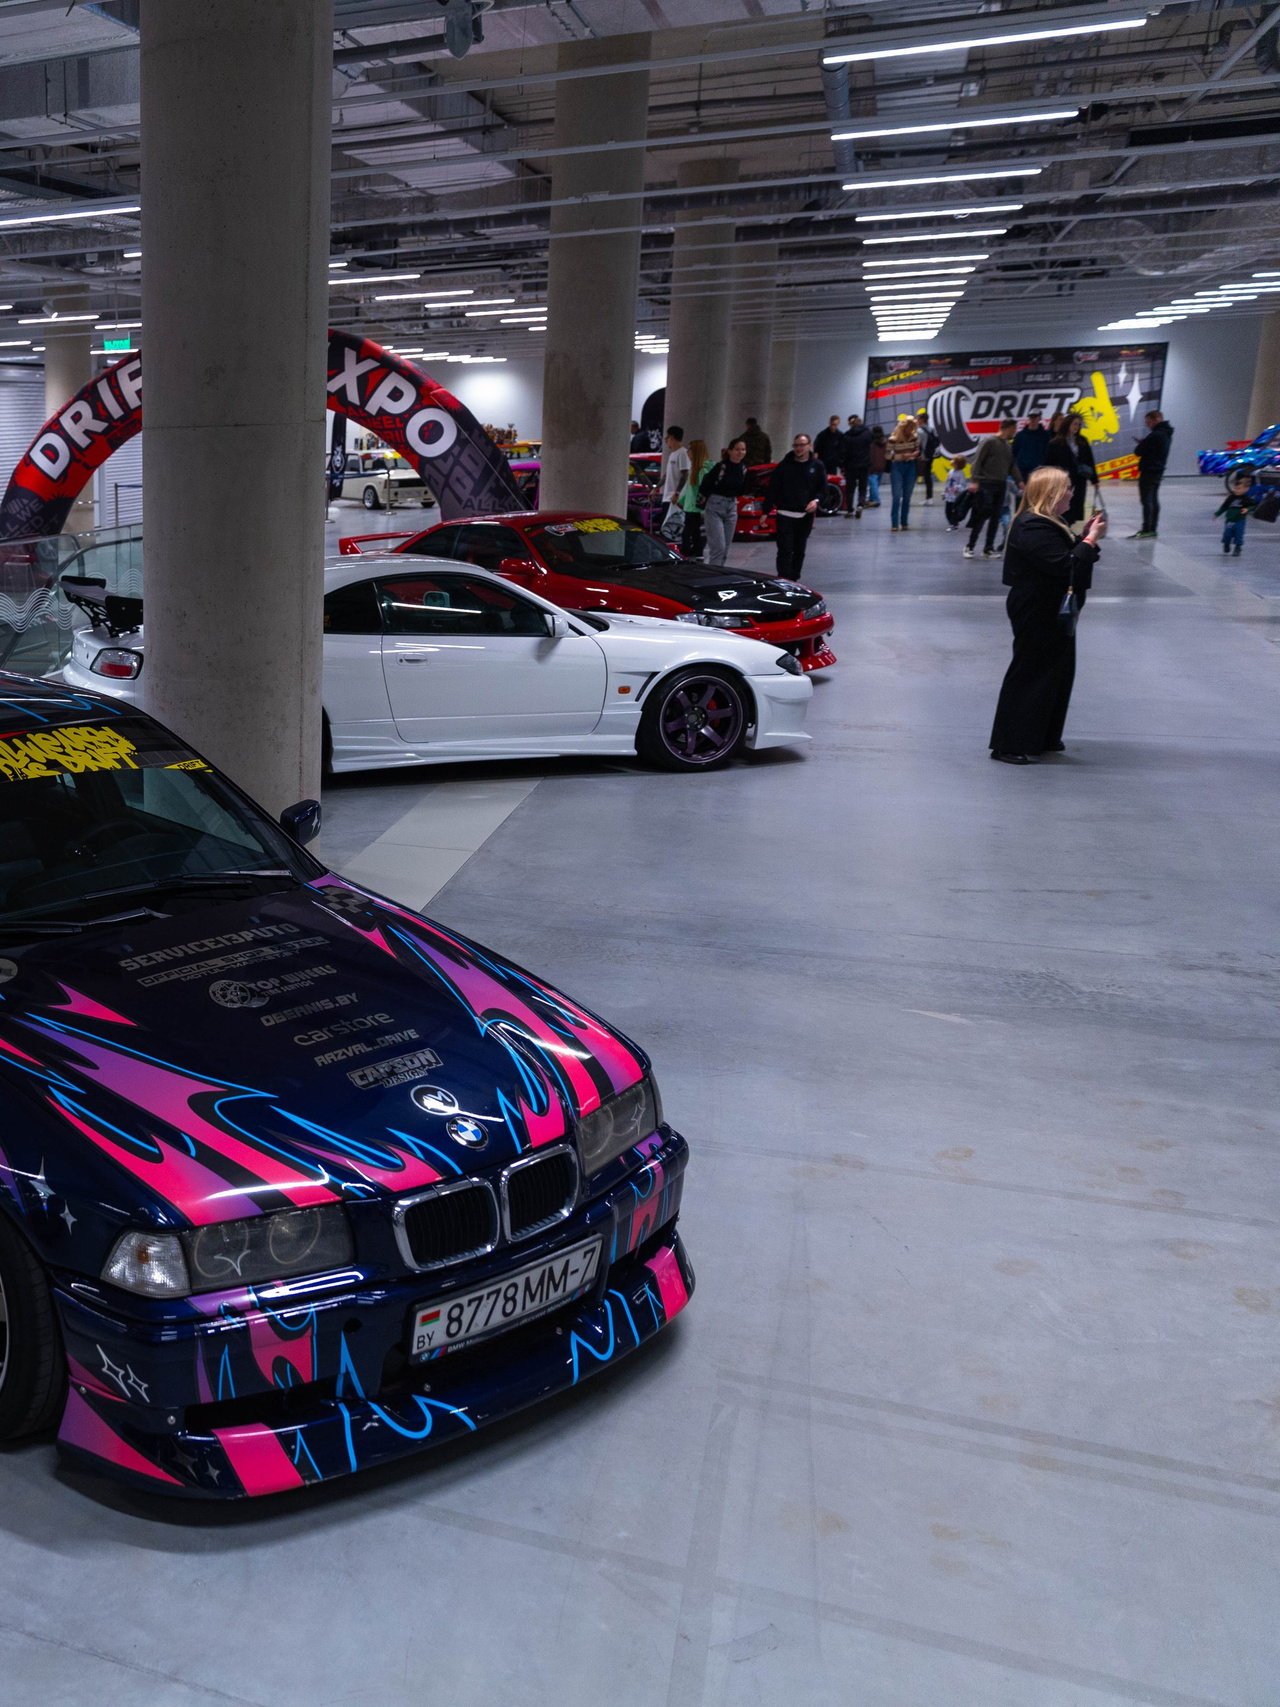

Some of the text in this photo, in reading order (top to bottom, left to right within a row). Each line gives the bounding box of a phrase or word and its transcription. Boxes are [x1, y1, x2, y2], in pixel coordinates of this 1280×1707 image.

[29, 358, 142, 480] DRIF
[327, 346, 457, 458] XPO
[970, 392, 1075, 420] DRIFT
[177, 759, 203, 771] DRIFT
[119, 923, 300, 971] SERVICE13AUTO
[141, 962, 219, 985] OFFICIAL
[220, 948, 266, 965] SHOP
[245, 964, 338, 992] TOP WHEELS
[260, 992, 359, 1027] OBERNIS.BY
[293, 1012, 395, 1046] carstore
[313, 1028, 420, 1067] RAZVAL_DRIVE
[383, 1066, 428, 1087] DESIGN
[416, 1331, 435, 1350] BY
[447, 1341, 465, 1353] BMW
